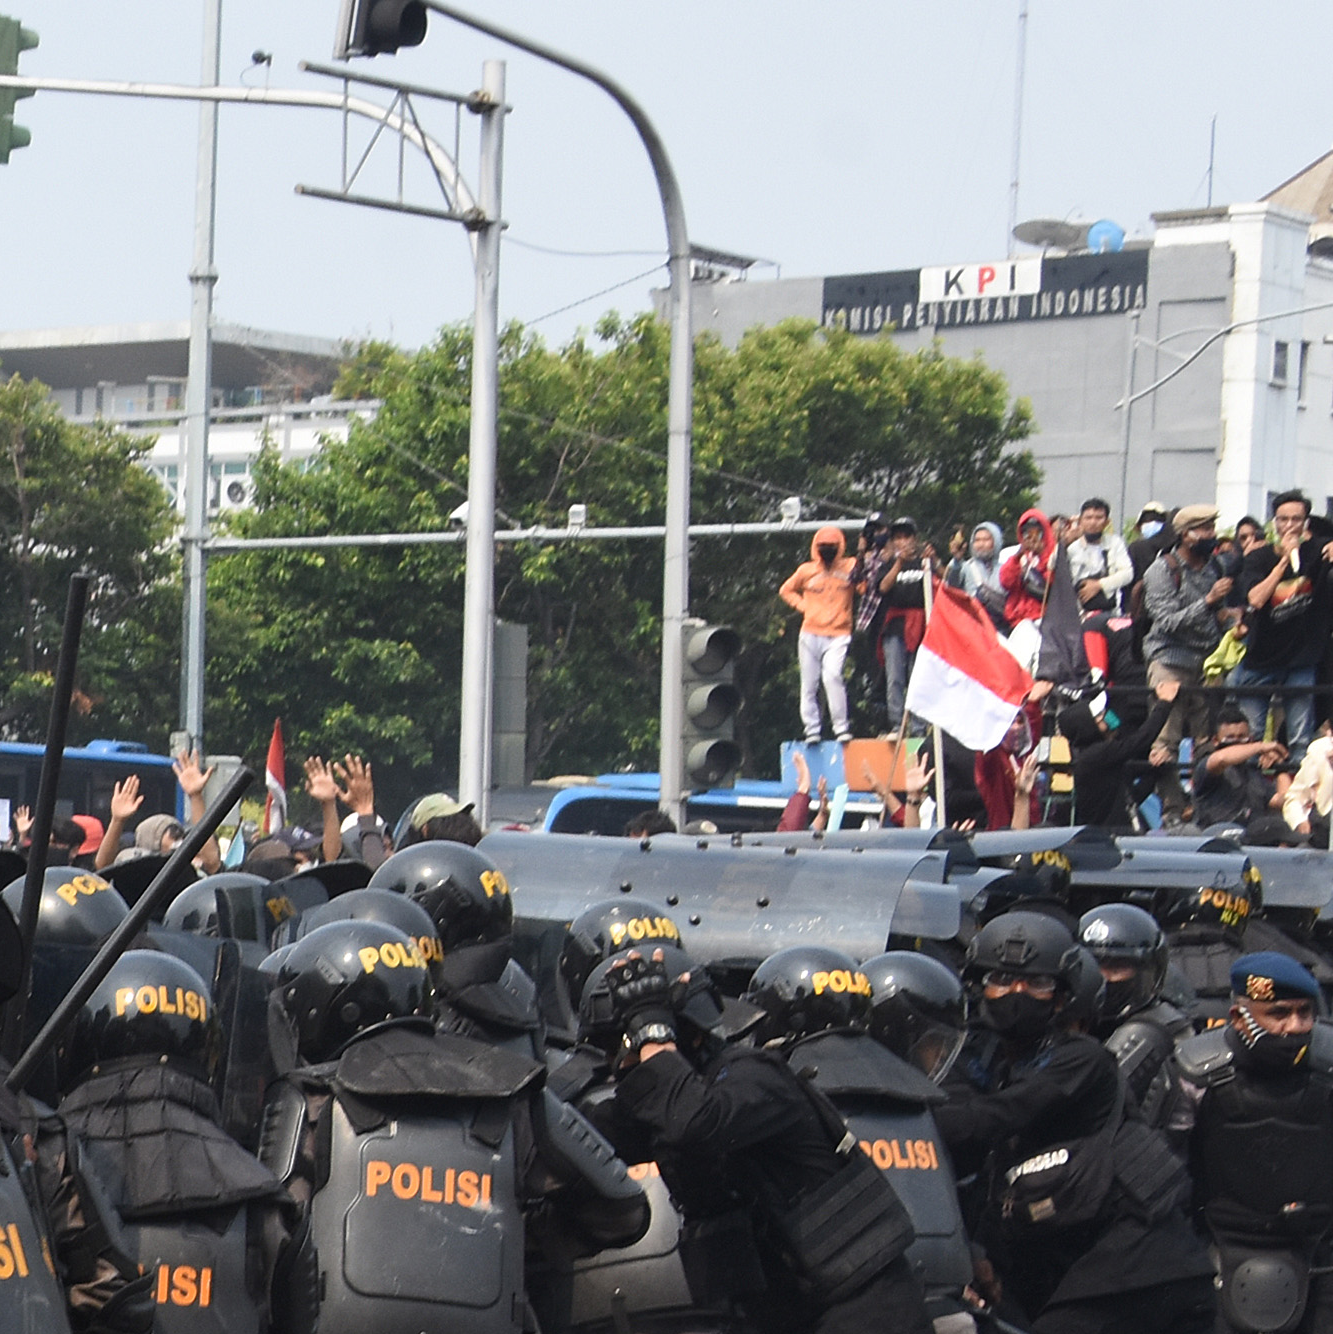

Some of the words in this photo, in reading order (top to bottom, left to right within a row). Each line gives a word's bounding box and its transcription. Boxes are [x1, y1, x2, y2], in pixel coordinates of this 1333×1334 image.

[944, 264, 1017, 295] KPI
[901, 294, 1019, 327] PENYIARAN
[1032, 283, 1146, 319] INDONESIA
[115, 984, 207, 1023] POLISI
[366, 1160, 493, 1210] POLISI
